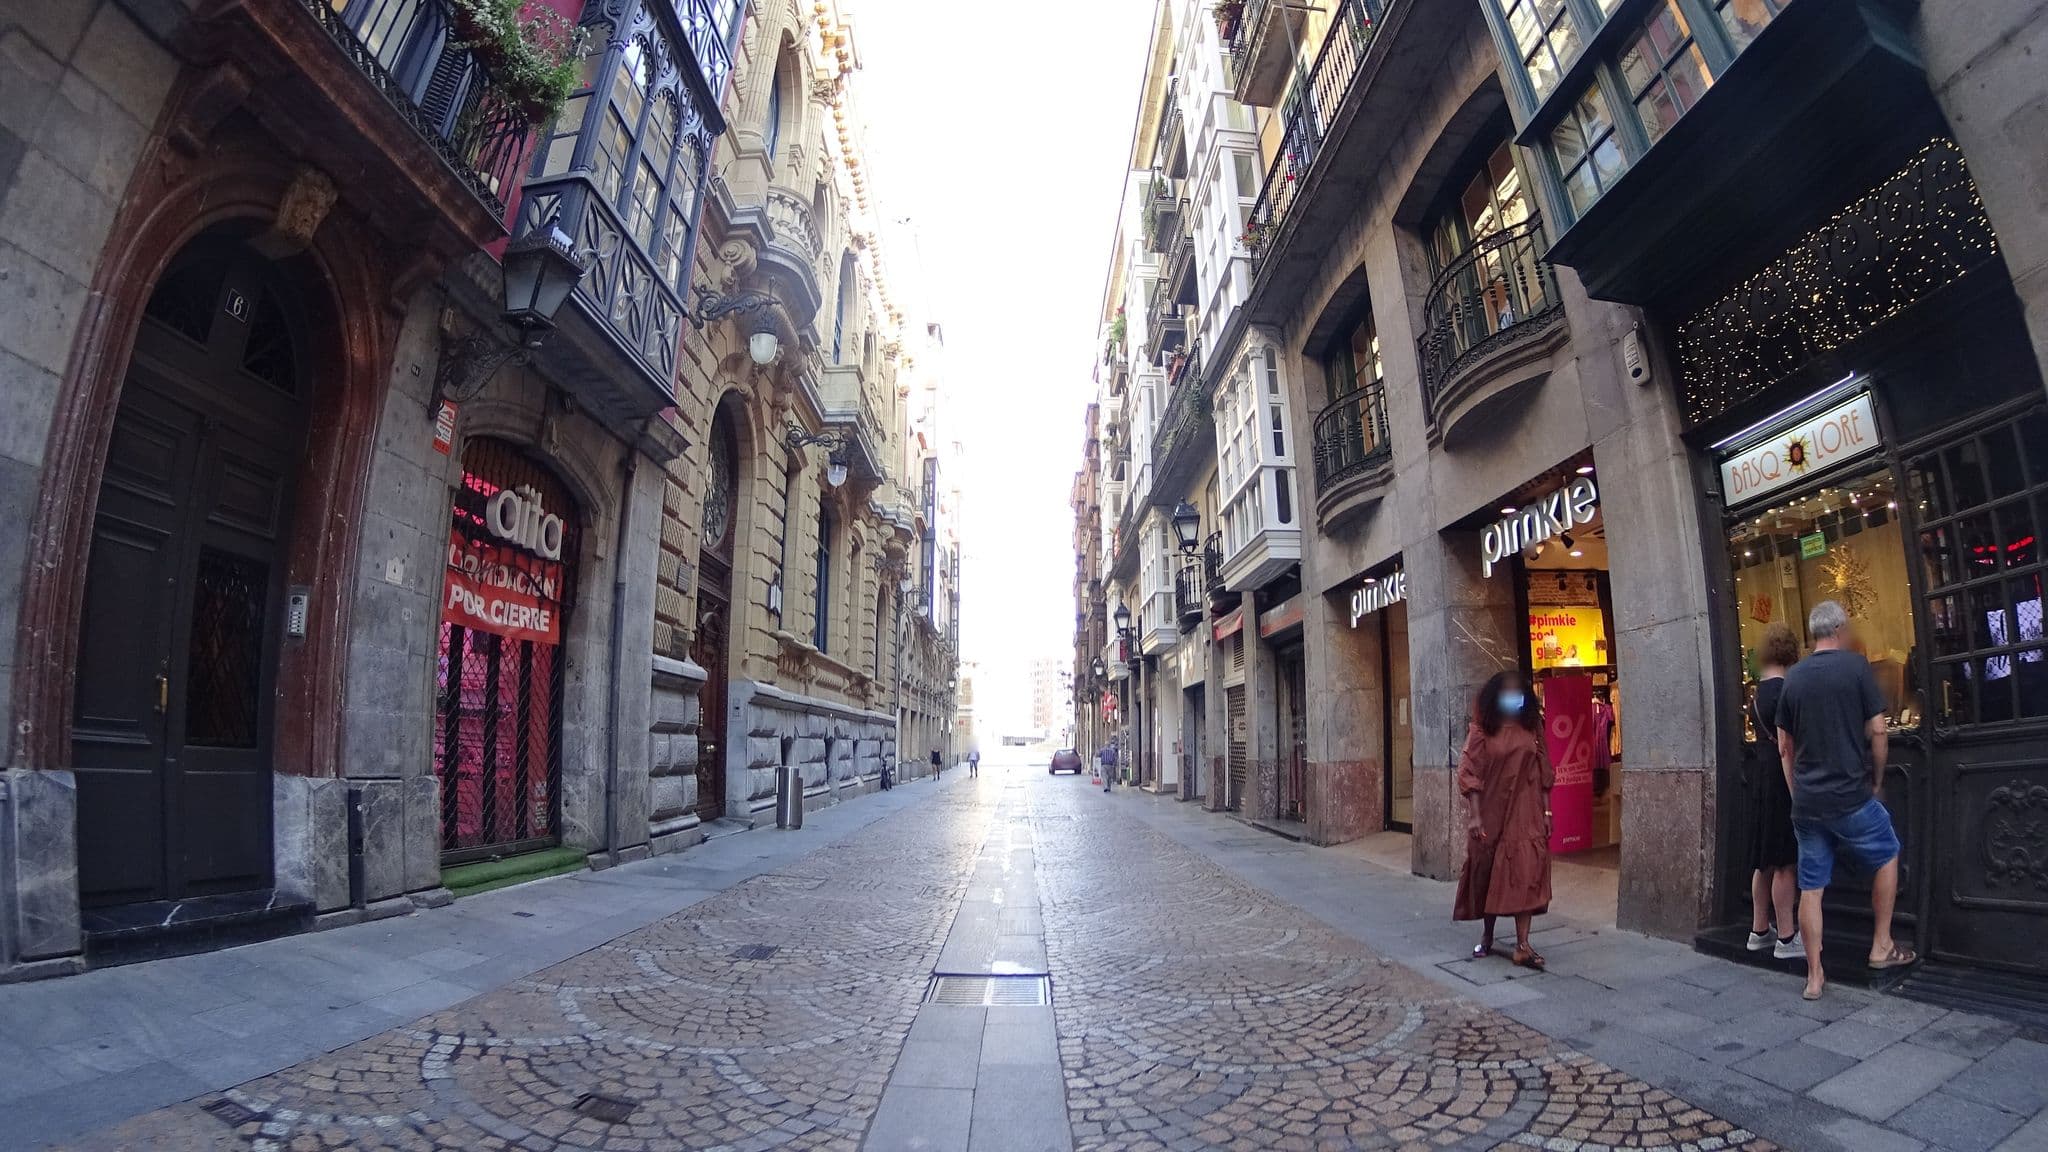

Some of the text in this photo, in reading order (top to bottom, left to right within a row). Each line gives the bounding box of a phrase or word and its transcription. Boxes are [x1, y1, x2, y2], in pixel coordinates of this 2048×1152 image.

[234, 296, 244, 315] 6
[1731, 409, 1863, 494] BASQ LORE
[1479, 475, 1597, 579] pimkie
[447, 584, 551, 632] POR CIERRE
